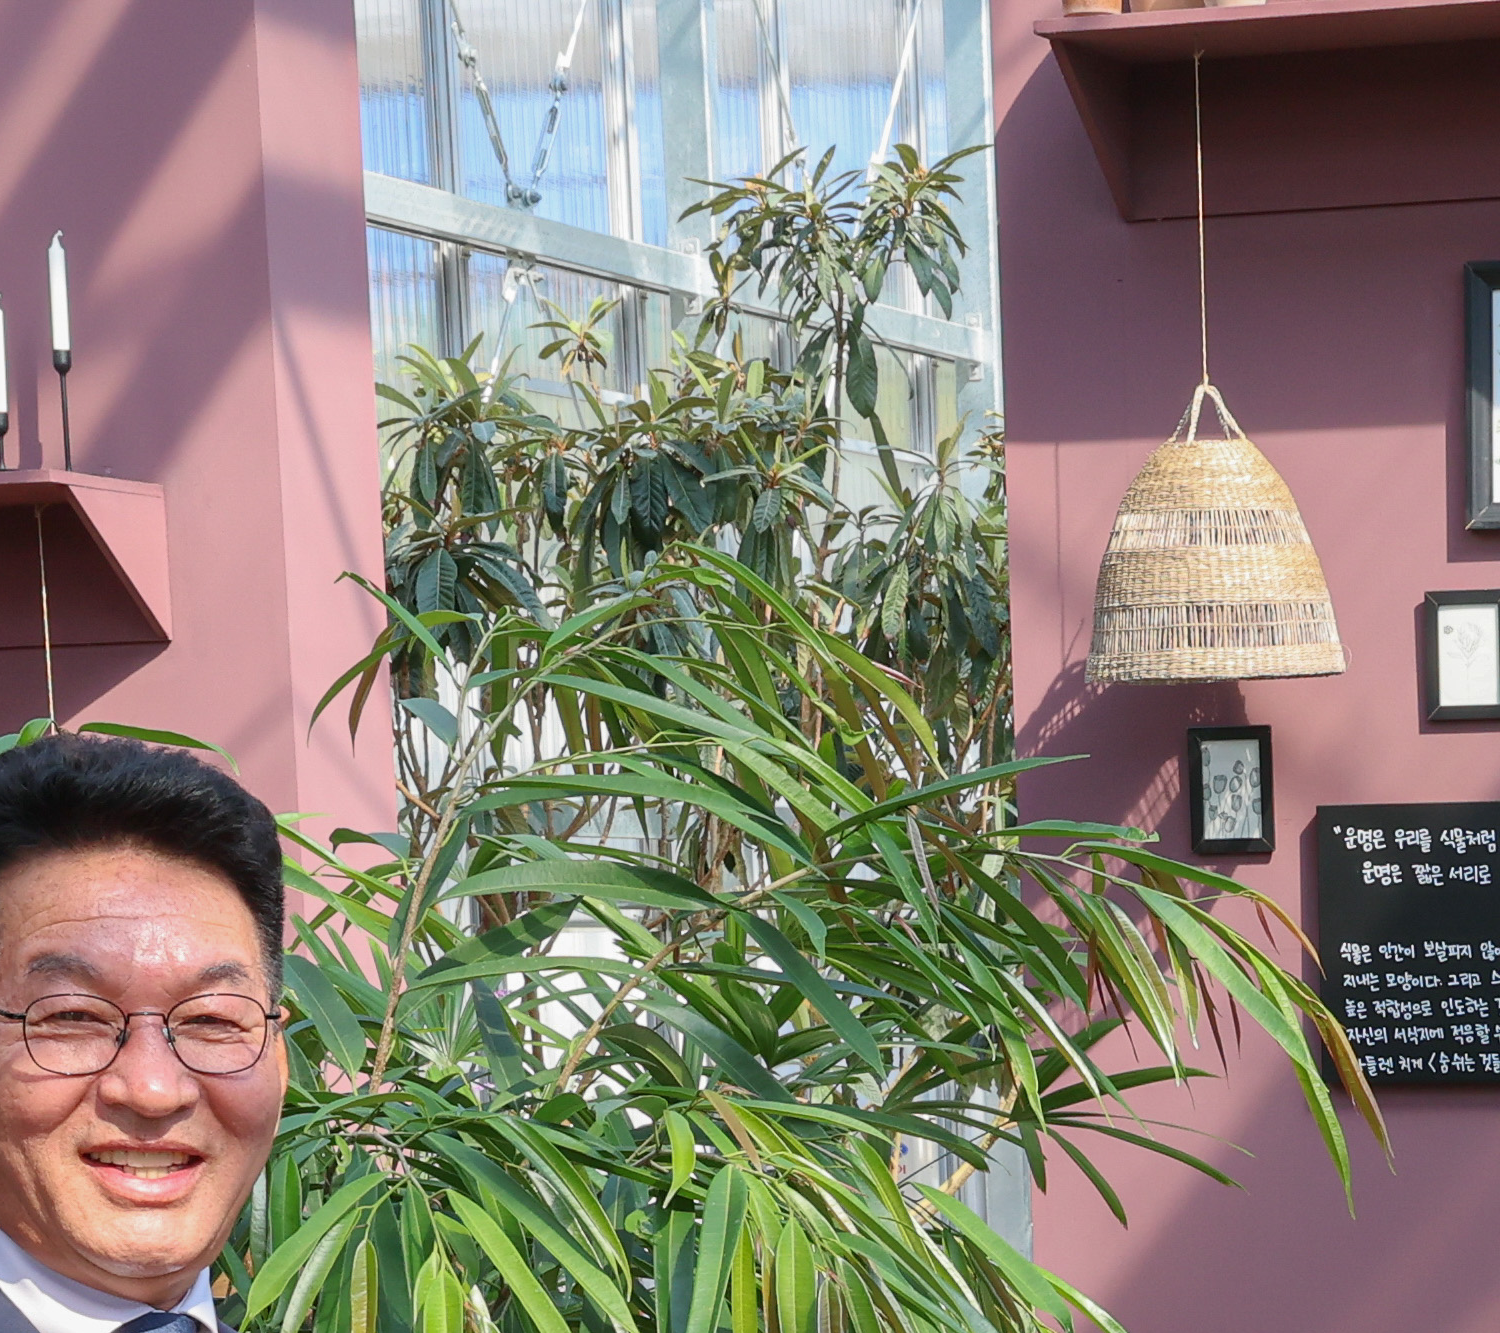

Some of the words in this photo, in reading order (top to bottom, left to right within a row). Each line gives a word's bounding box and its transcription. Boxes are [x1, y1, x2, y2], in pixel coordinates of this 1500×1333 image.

[1394, 827, 1432, 853] 우리를
[1440, 830, 1496, 854] 식물처럼
[1362, 861, 1403, 886] 운명은
[1412, 863, 1445, 886] 짧은
[1449, 865, 1491, 885] 서리로
[1340, 942, 1372, 960] 식물은
[1378, 943, 1416, 960] 인간이
[1423, 940, 1473, 959] 보살피지
[1343, 973, 1379, 991] 지내는
[1386, 972, 1443, 991] 모양이다.
[1447, 973, 1482, 988] 그리고
[1345, 998, 1368, 1019] 높은
[1373, 999, 1433, 1020] 적합성으로
[1441, 998, 1489, 1018] 인도하는
[1347, 1026, 1388, 1044] 자신의
[1394, 1025, 1445, 1044] 서식지에
